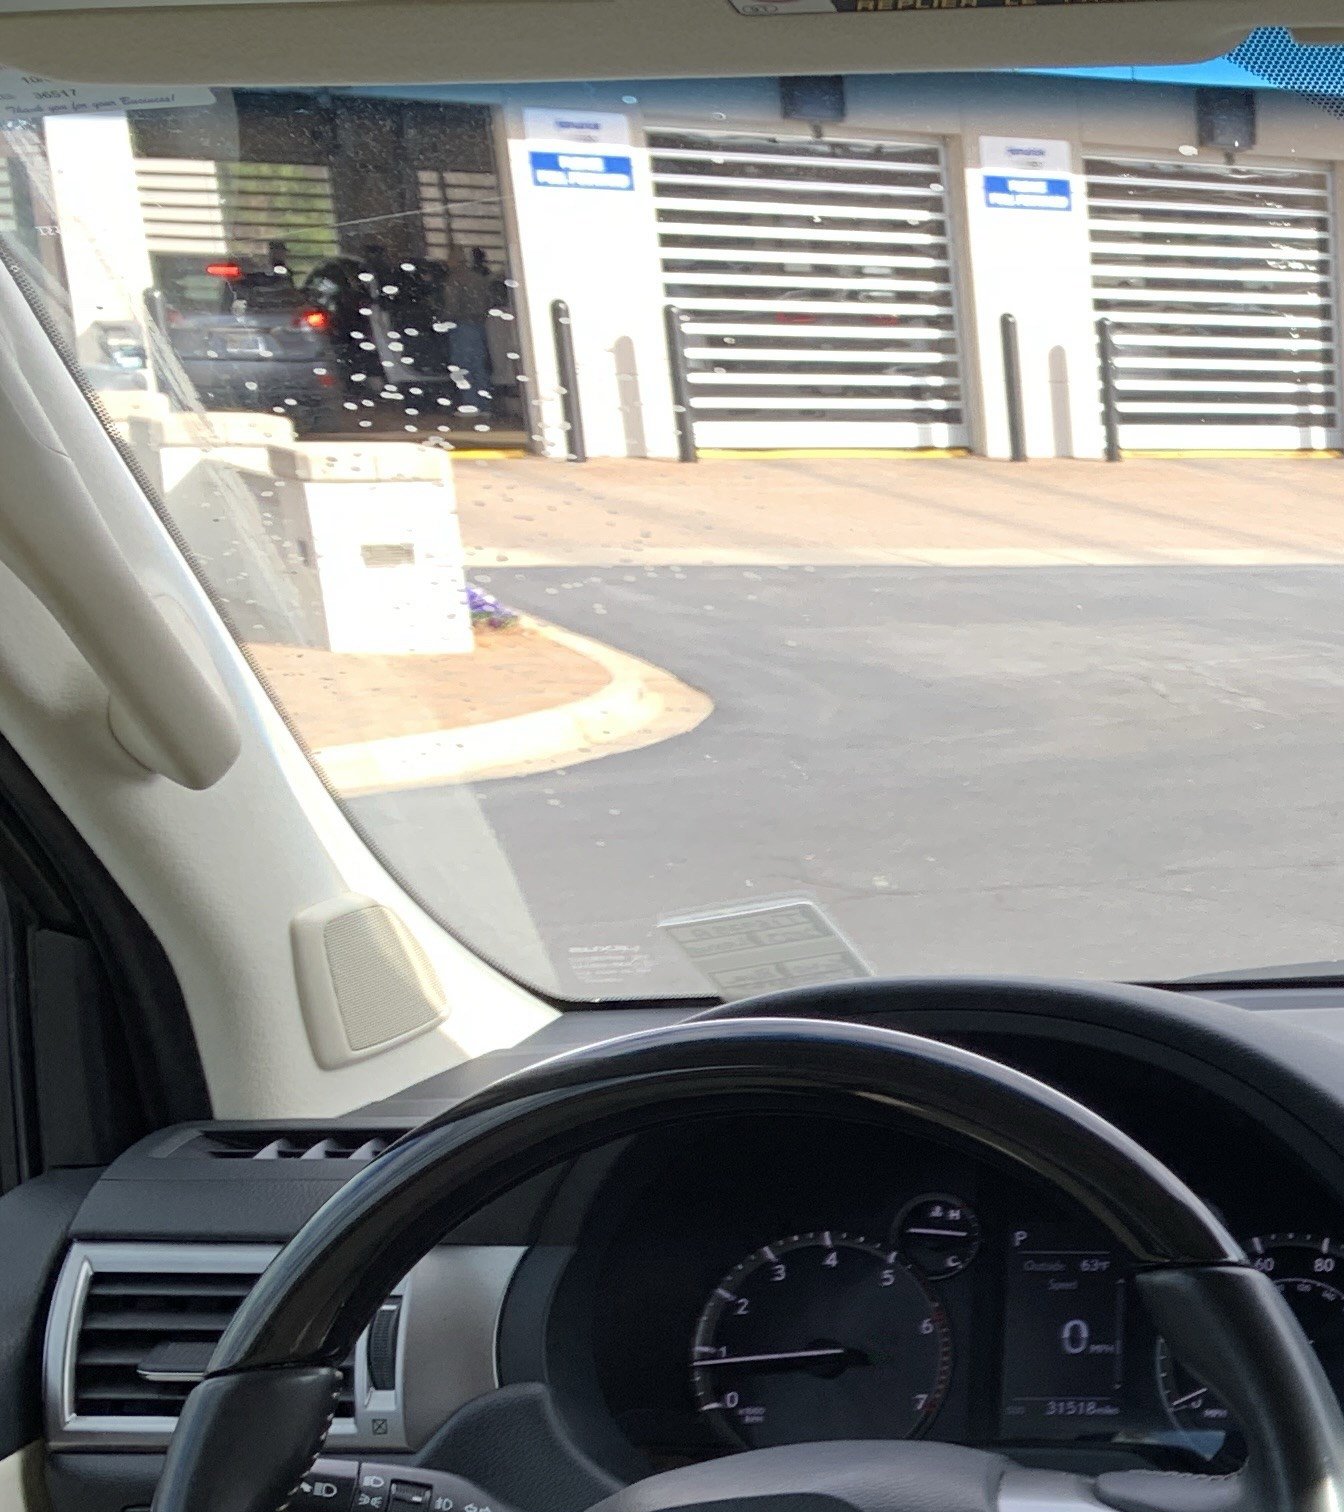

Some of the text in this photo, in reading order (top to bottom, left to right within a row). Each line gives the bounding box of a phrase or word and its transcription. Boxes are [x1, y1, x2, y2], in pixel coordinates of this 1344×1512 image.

[1013, 1231, 1028, 1246] P
[822, 1252, 838, 1268] 4
[1313, 1258, 1335, 1272] 80
[770, 1265, 785, 1281] 3
[881, 1270, 895, 1286] 5
[734, 1299, 749, 1315] 2
[919, 1318, 934, 1334] 6
[1062, 1318, 1089, 1354] 0
[725, 1391, 739, 1408] 0
[913, 1394, 928, 1410] 7
